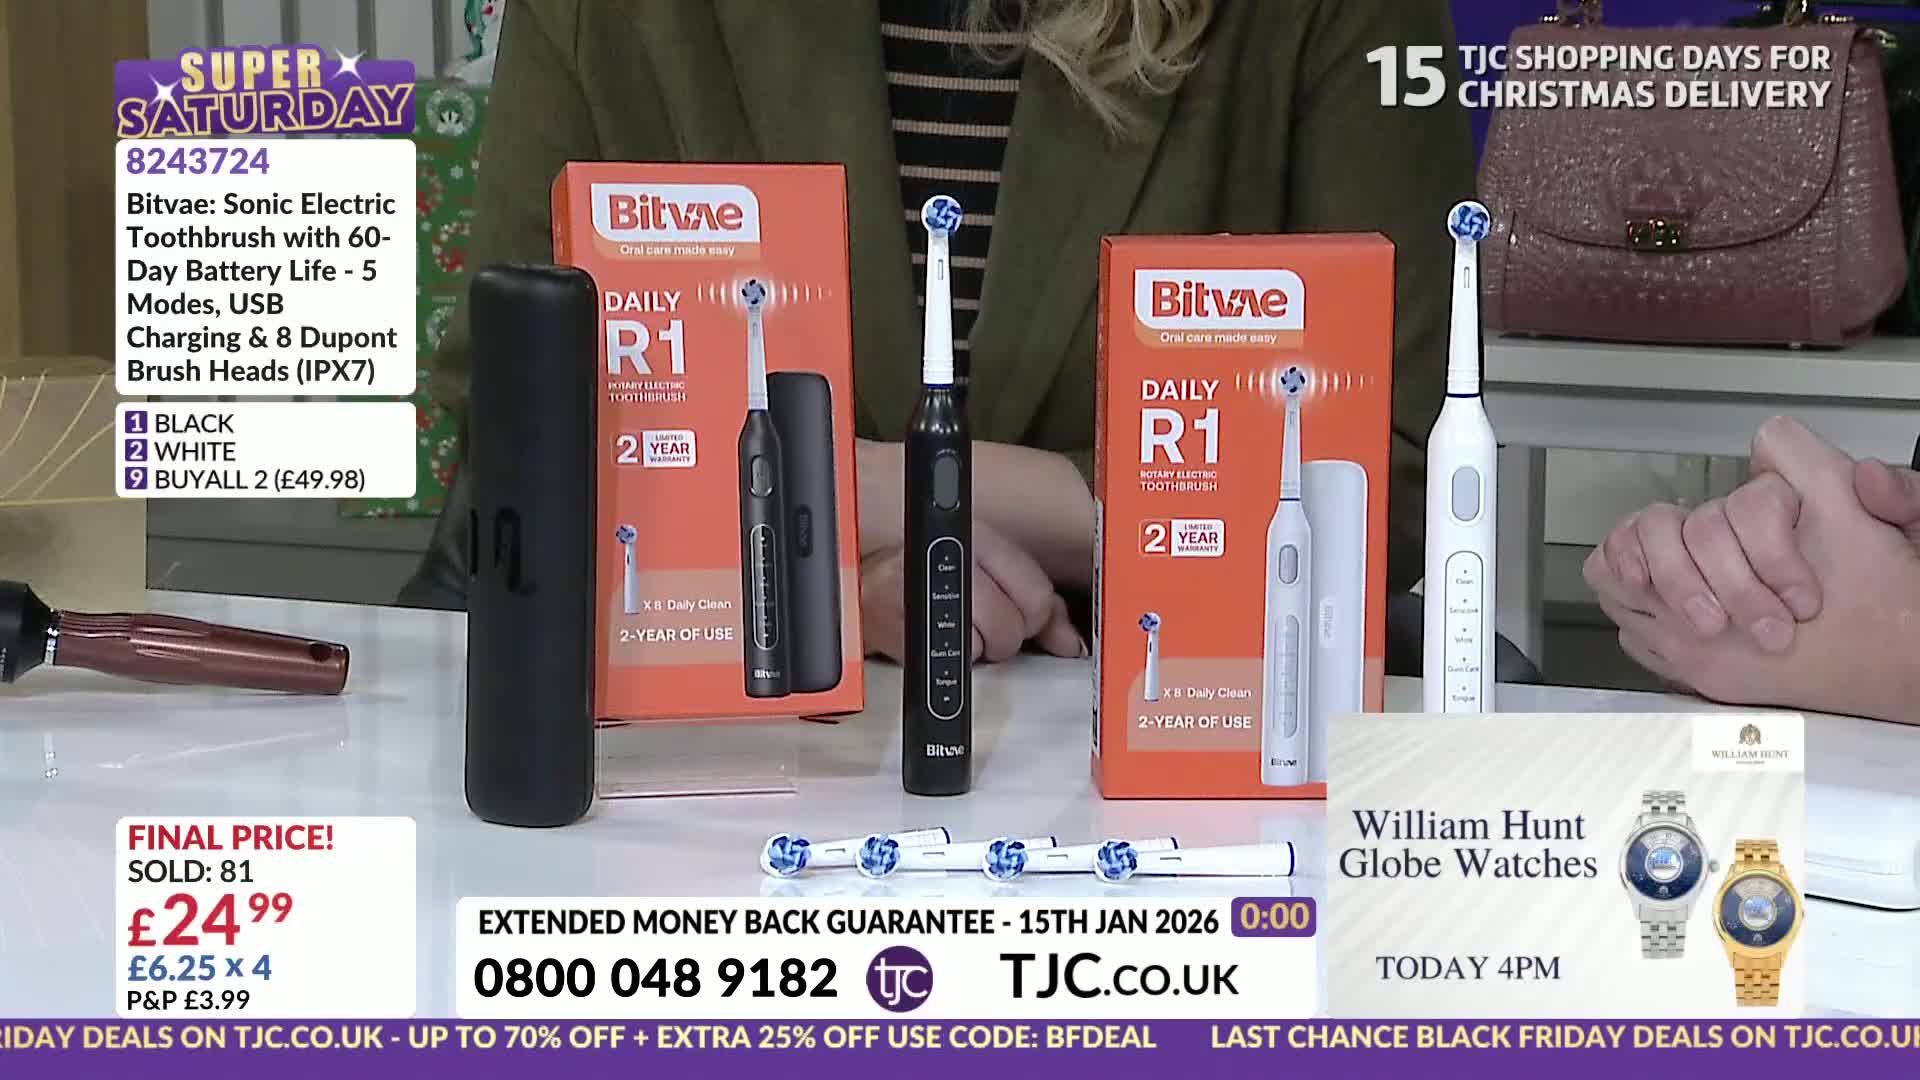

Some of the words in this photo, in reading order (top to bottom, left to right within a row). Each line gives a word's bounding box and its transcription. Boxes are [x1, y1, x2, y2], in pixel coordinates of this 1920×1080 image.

[620, 244, 644, 256] Oral
[646, 246, 671, 256] care
[673, 244, 707, 256] made
[708, 246, 735, 258] easy
[605, 290, 681, 313] DAILY
[1160, 332, 1183, 343] Oral
[1186, 334, 1212, 343] care
[1215, 332, 1247, 343] made
[1250, 334, 1278, 345] easy
[606, 319, 686, 375] R1
[608, 381, 644, 391] ROTARY
[644, 381, 685, 390] ELECTRIC
[1142, 380, 1219, 401] DAILY
[608, 392, 686, 403] TOOTHBRUSH
[1140, 407, 1219, 465] R1
[616, 434, 639, 464] 2
[650, 442, 690, 456] YEAR
[650, 455, 691, 464] WARRANTY
[1140, 470, 1175, 479] ROTARY
[1177, 470, 1217, 479] ELECTRIC
[1140, 481, 1218, 492] TOOTHBRUSH
[1144, 524, 1166, 553] 2
[1178, 531, 1218, 545] YEAR
[1178, 545, 1218, 553] WARRANTY
[667, 599, 695, 612] Daily
[698, 599, 732, 610] Clean
[620, 628, 677, 643] 2-YEAR
[679, 628, 702, 641] OF
[703, 627, 734, 641] USE
[1173, 688, 1181, 698] 8
[1187, 687, 1215, 701] Daily
[1218, 687, 1252, 698] Clean
[1138, 716, 1195, 729] 2-YEAR
[1198, 716, 1219, 729] OF
[1222, 716, 1252, 729] USE
